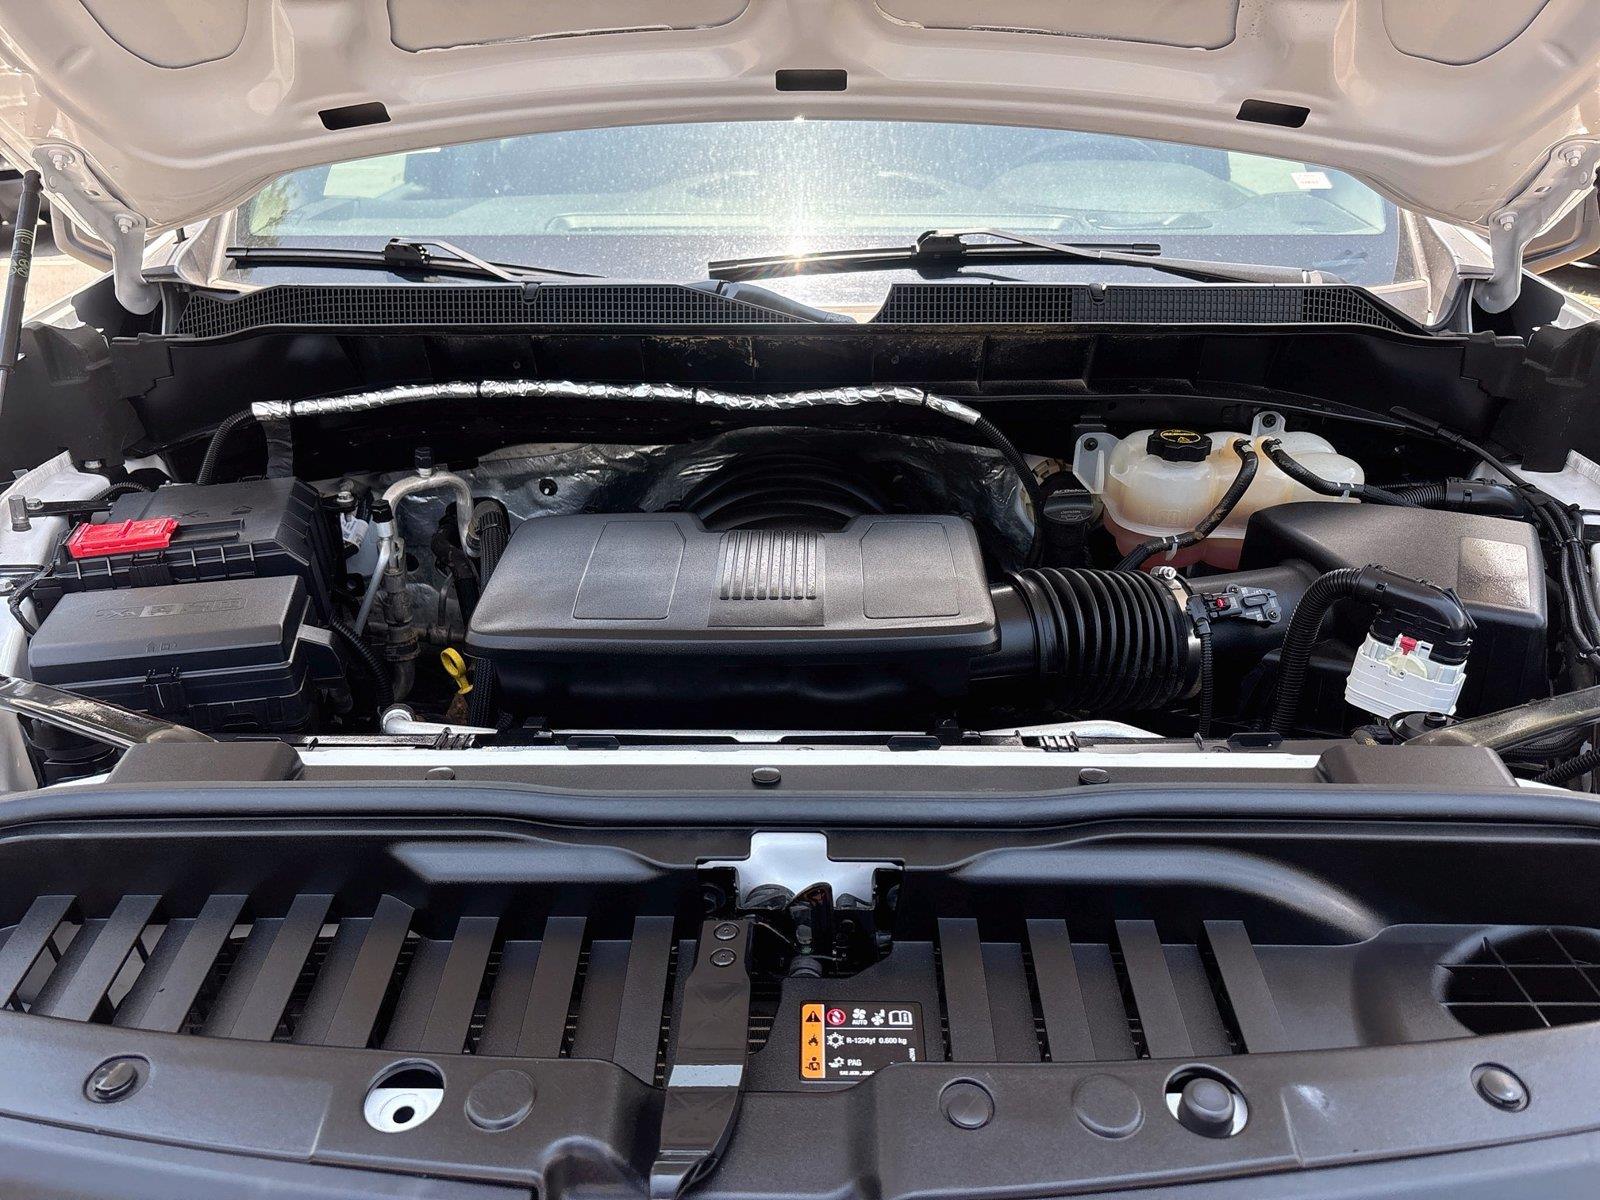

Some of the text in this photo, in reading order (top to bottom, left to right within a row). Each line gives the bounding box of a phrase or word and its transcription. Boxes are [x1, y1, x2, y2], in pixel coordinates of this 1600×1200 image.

[846, 1037, 876, 1045] R-1234yf
[898, 1037, 907, 1045] kg
[847, 1058, 862, 1066] PAG
